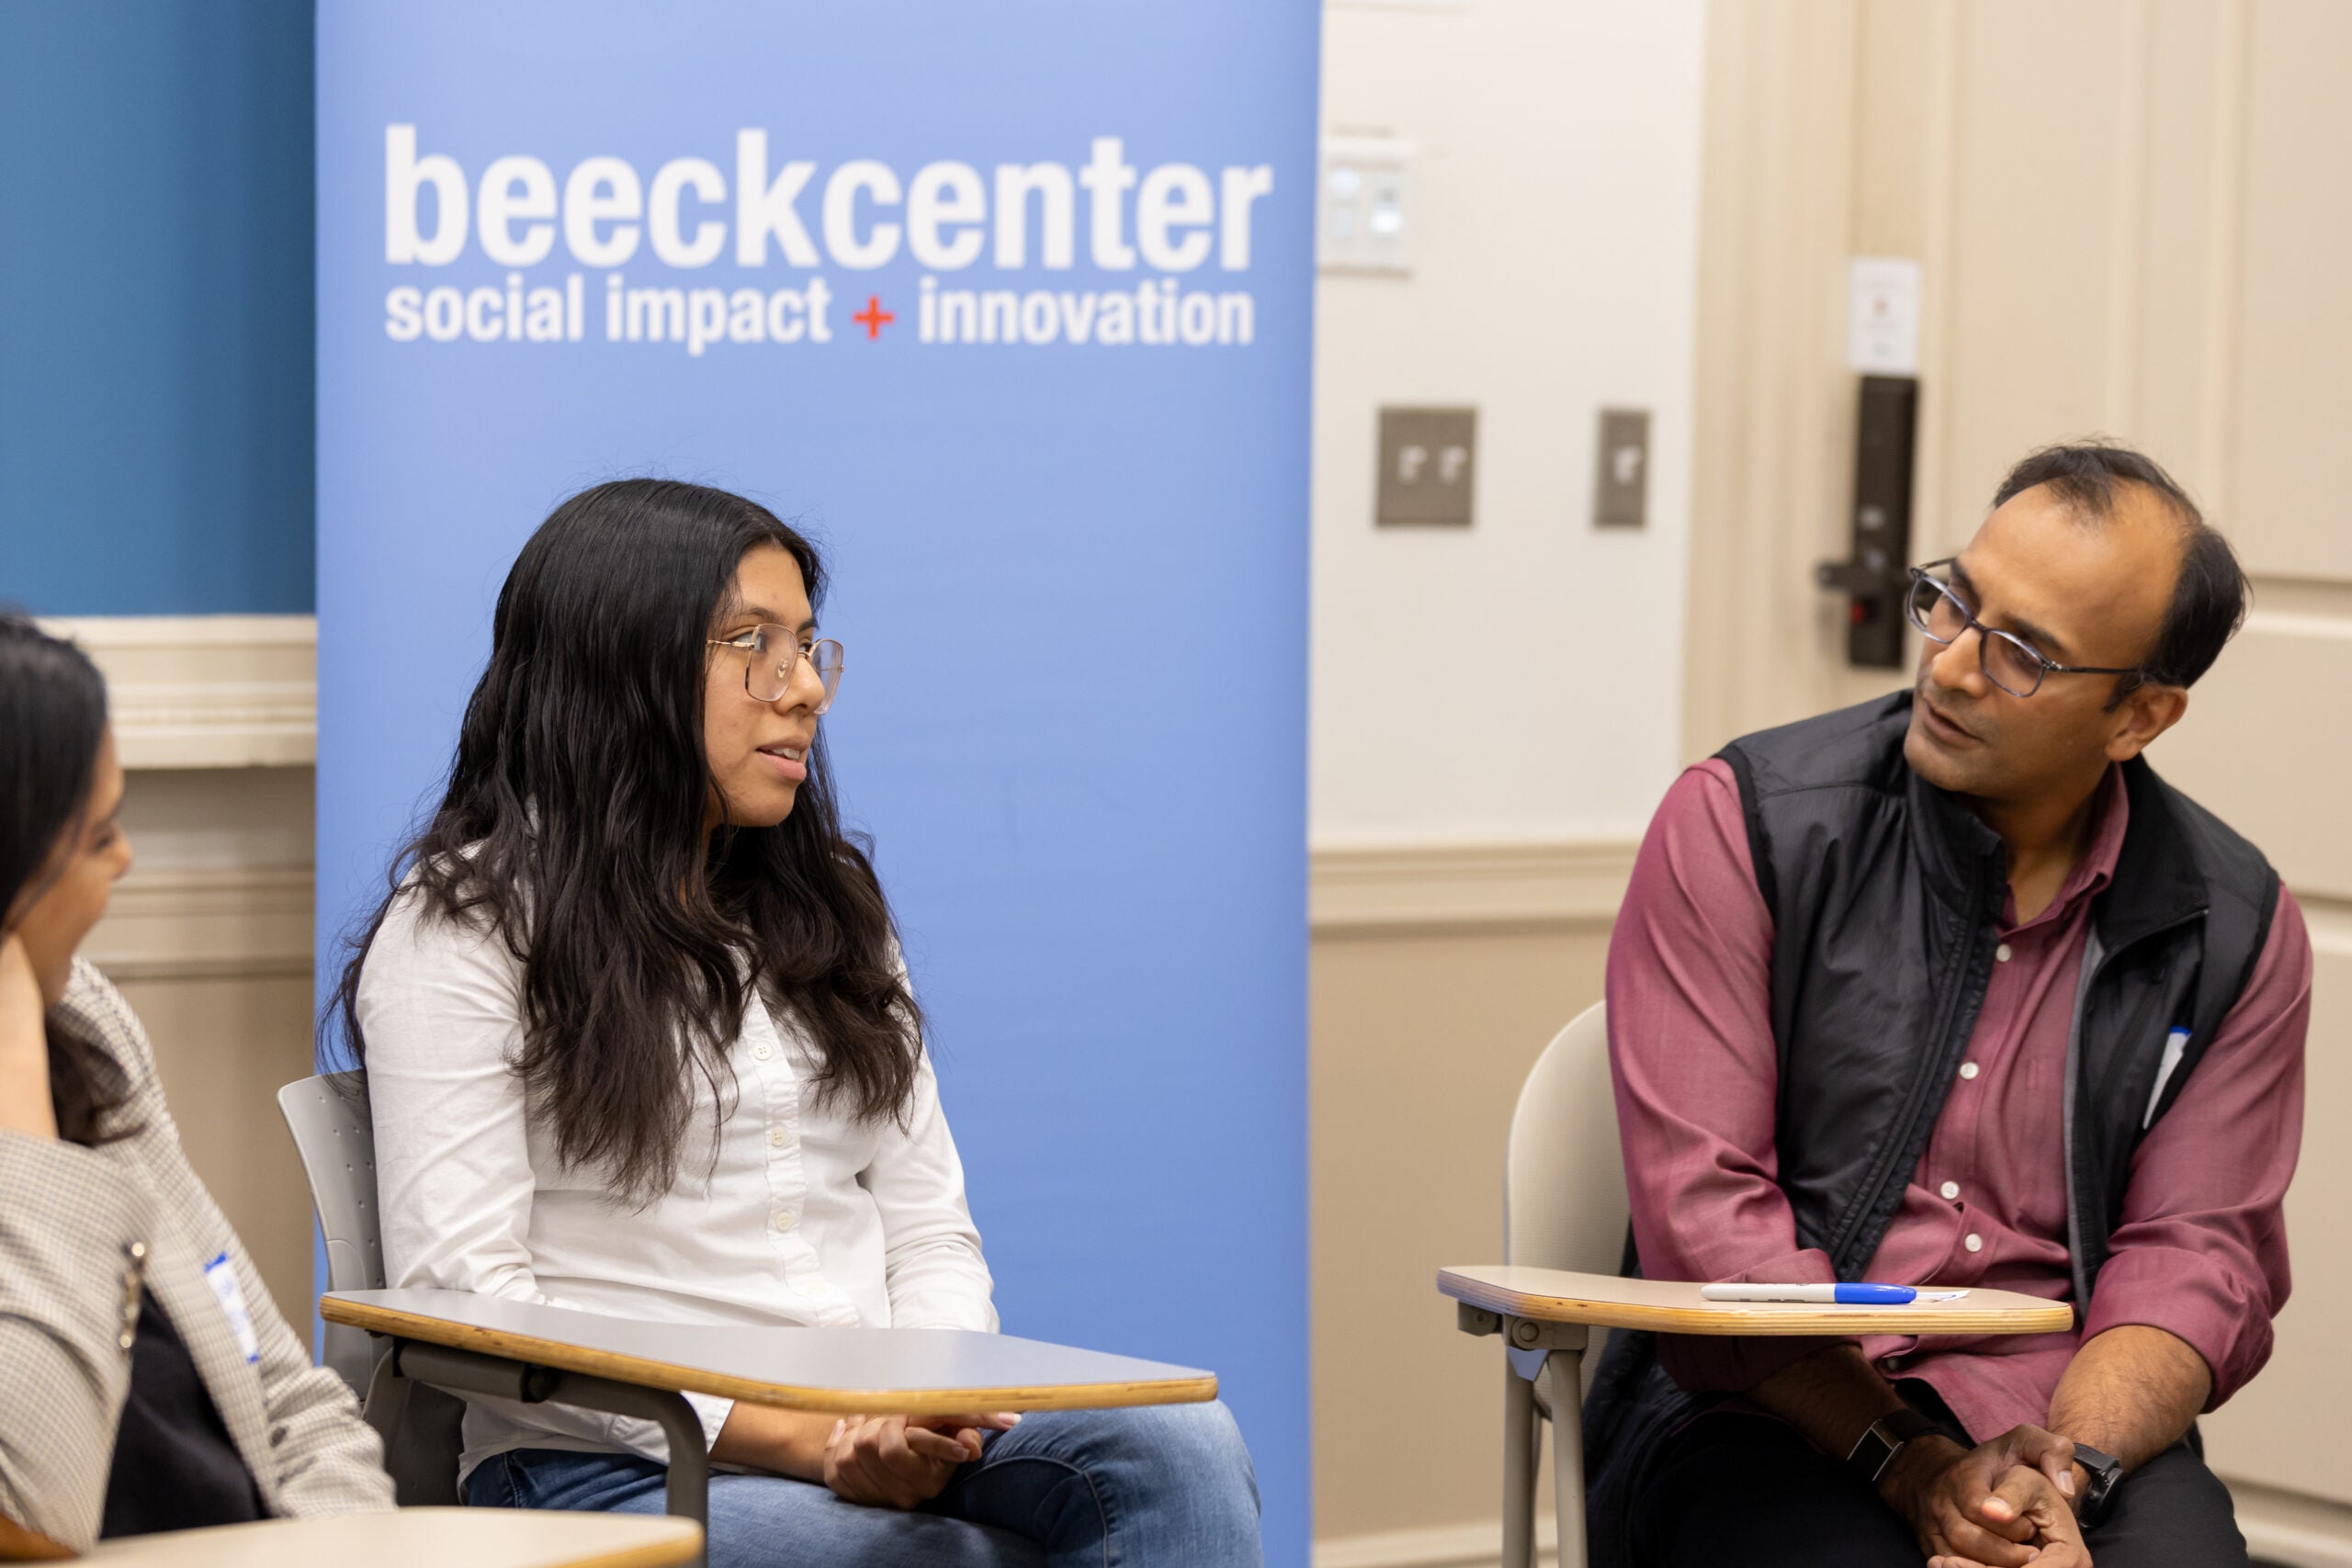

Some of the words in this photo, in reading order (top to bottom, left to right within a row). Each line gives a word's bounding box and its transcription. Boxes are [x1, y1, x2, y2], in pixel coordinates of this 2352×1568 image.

[385, 124, 1272, 271] beeckcenter
[385, 273, 583, 342] social
[606, 274, 831, 355] impact
[853, 296, 894, 341] +
[920, 276, 1253, 344] innovation
